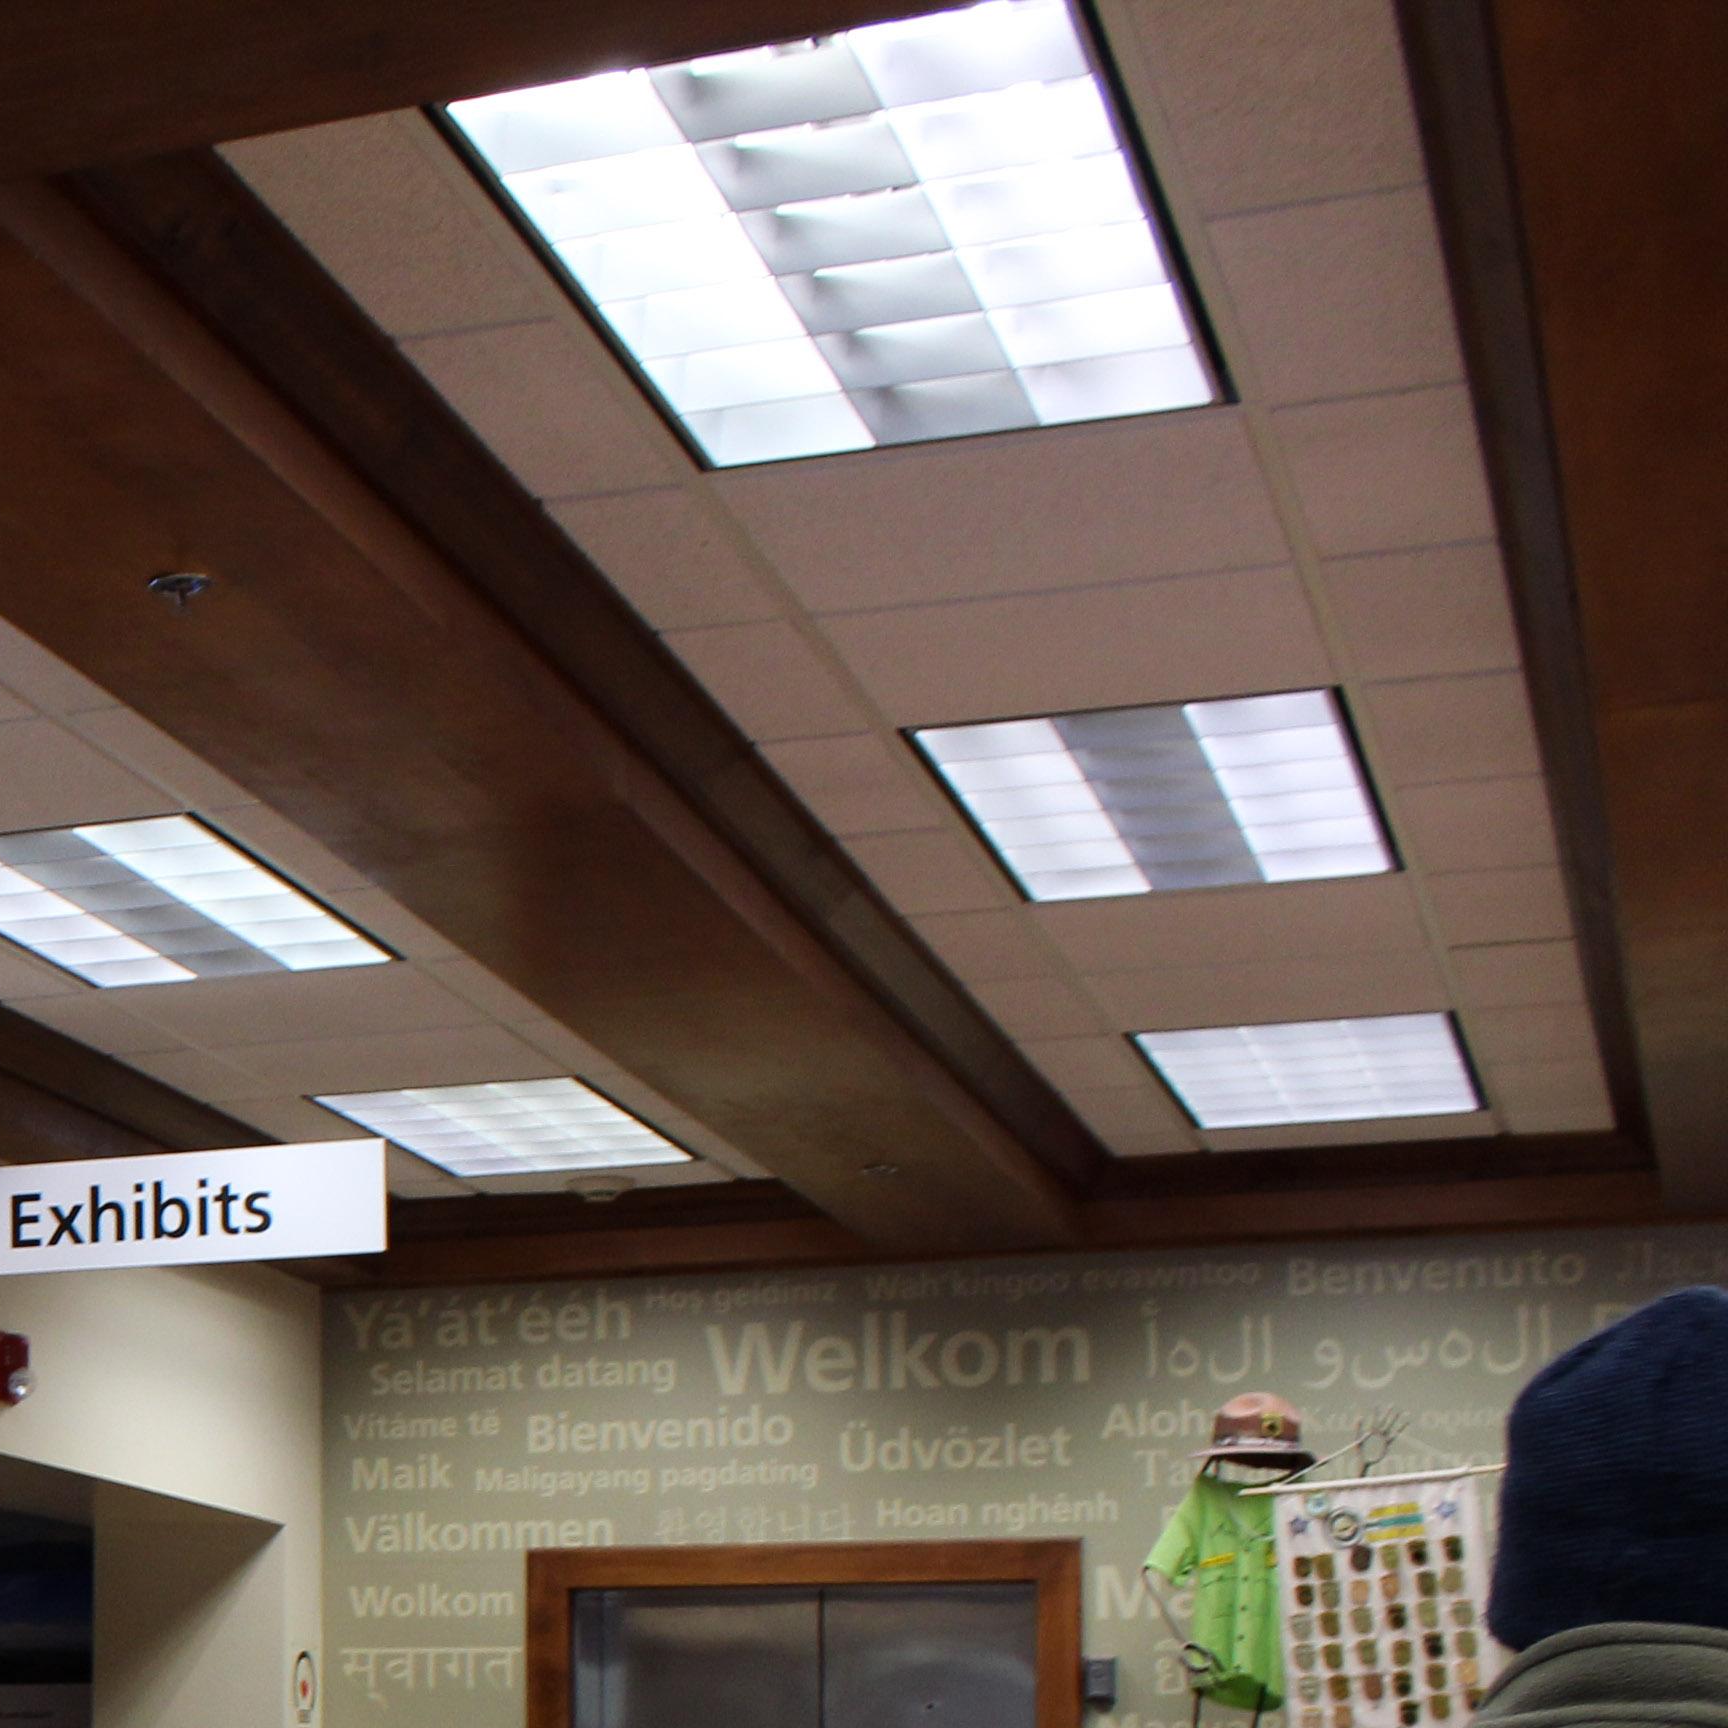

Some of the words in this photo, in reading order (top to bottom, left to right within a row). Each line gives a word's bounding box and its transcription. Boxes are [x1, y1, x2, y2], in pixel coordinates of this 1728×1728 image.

[10, 1178, 273, 1248] Exhibits
[1290, 1250, 1587, 1297] Benvenuto
[370, 1359, 524, 1397] Selamat
[535, 1352, 677, 1393] datang
[705, 1310, 1092, 1396] Welkom
[526, 1403, 794, 1453] Bienvenido
[1101, 1401, 1213, 1441] Aloh
[839, 1420, 1073, 1474] Üdvözlet
[351, 1453, 453, 1491] Maik
[474, 1464, 651, 1497] Maligayang
[659, 1457, 821, 1494] pagdating
[344, 1511, 615, 1554] Välkommen
[876, 1498, 970, 1529] Hoan
[349, 1584, 515, 1619] Wolkom
